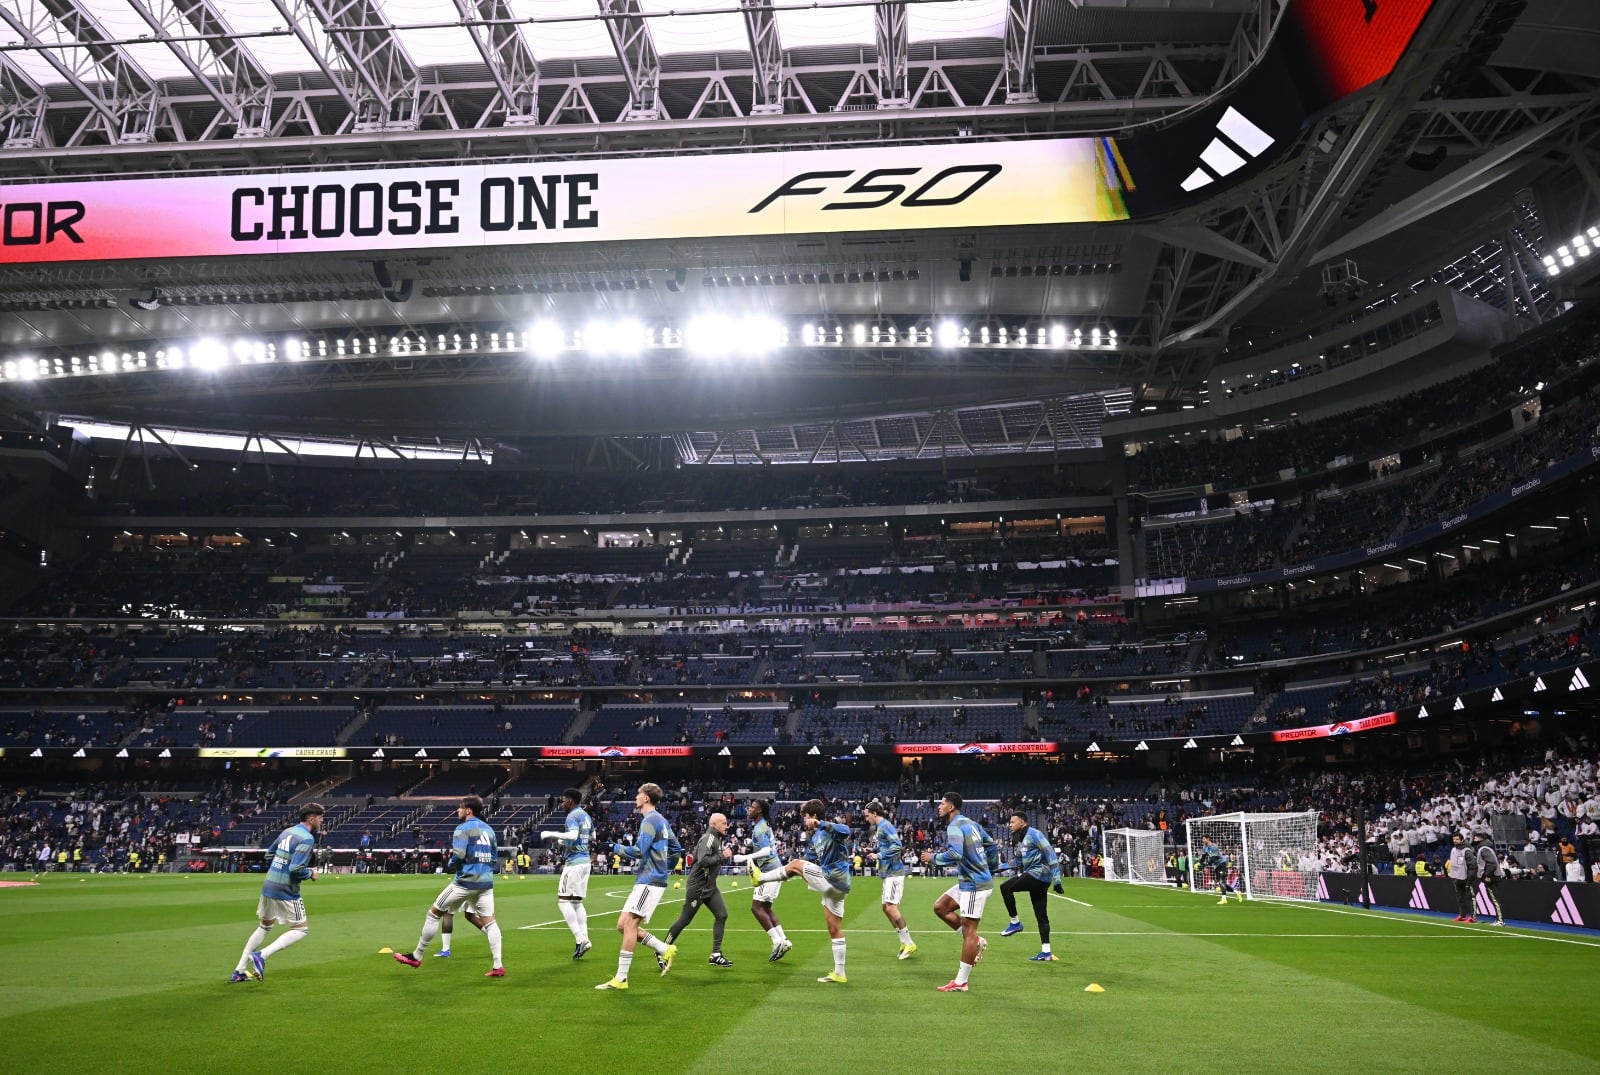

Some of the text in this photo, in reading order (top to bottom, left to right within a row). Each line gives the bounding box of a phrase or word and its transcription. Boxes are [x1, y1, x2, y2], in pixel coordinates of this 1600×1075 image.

[747, 163, 1003, 214] F50
[230, 173, 599, 242] CHOOSE ONE
[0, 201, 86, 246] OR
[1017, 743, 1049, 751] CONTROL
[1280, 729, 1317, 739] PREDATOR
[655, 747, 684, 755] CONTROL
